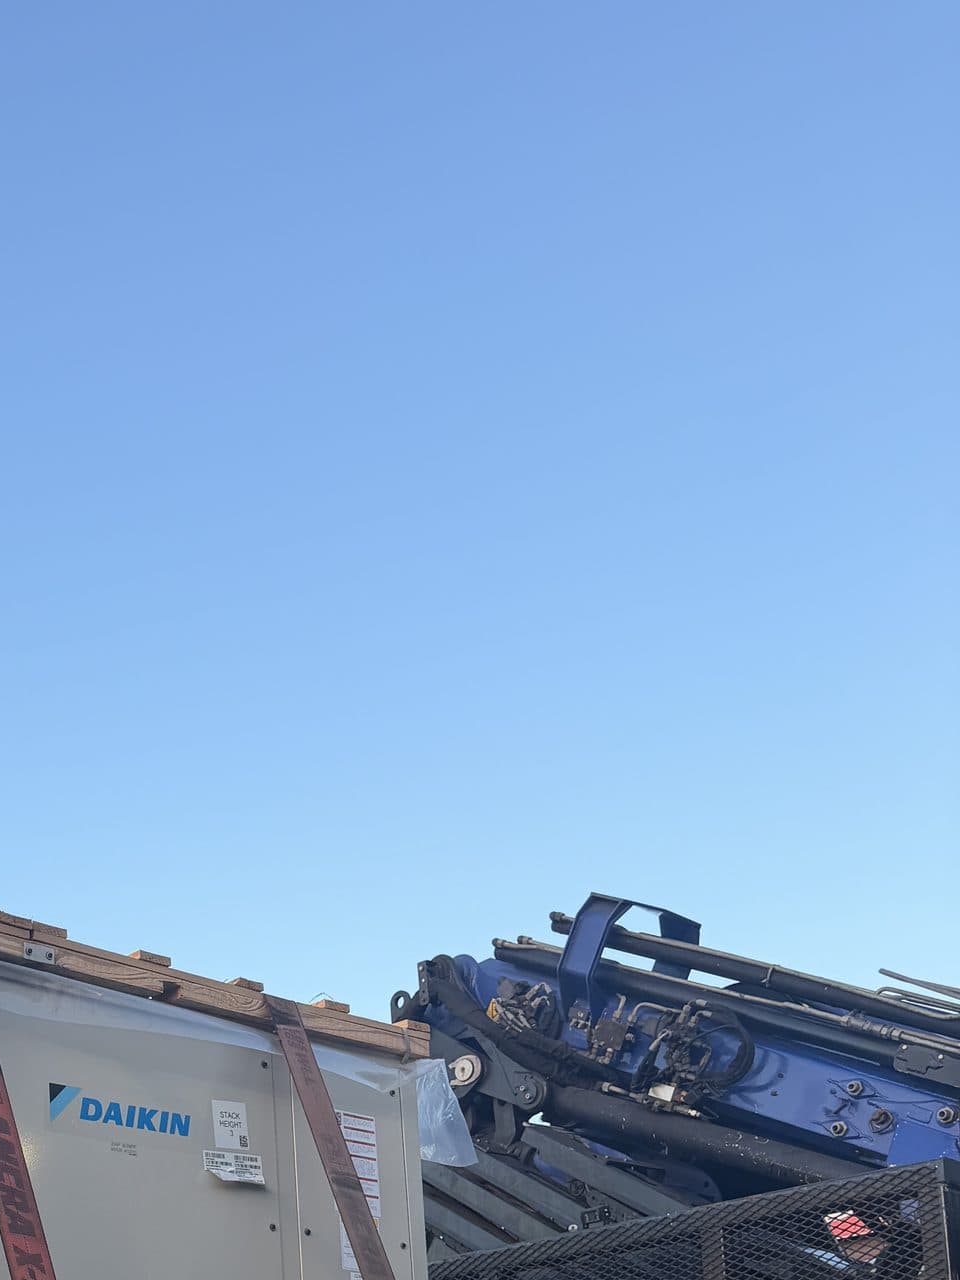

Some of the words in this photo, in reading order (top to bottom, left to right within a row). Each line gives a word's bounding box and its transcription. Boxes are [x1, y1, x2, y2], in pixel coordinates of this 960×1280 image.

[80, 1097, 191, 1137] DAIKIN
[220, 1111, 241, 1120] STACK
[219, 1120, 242, 1129] HEIGHT
